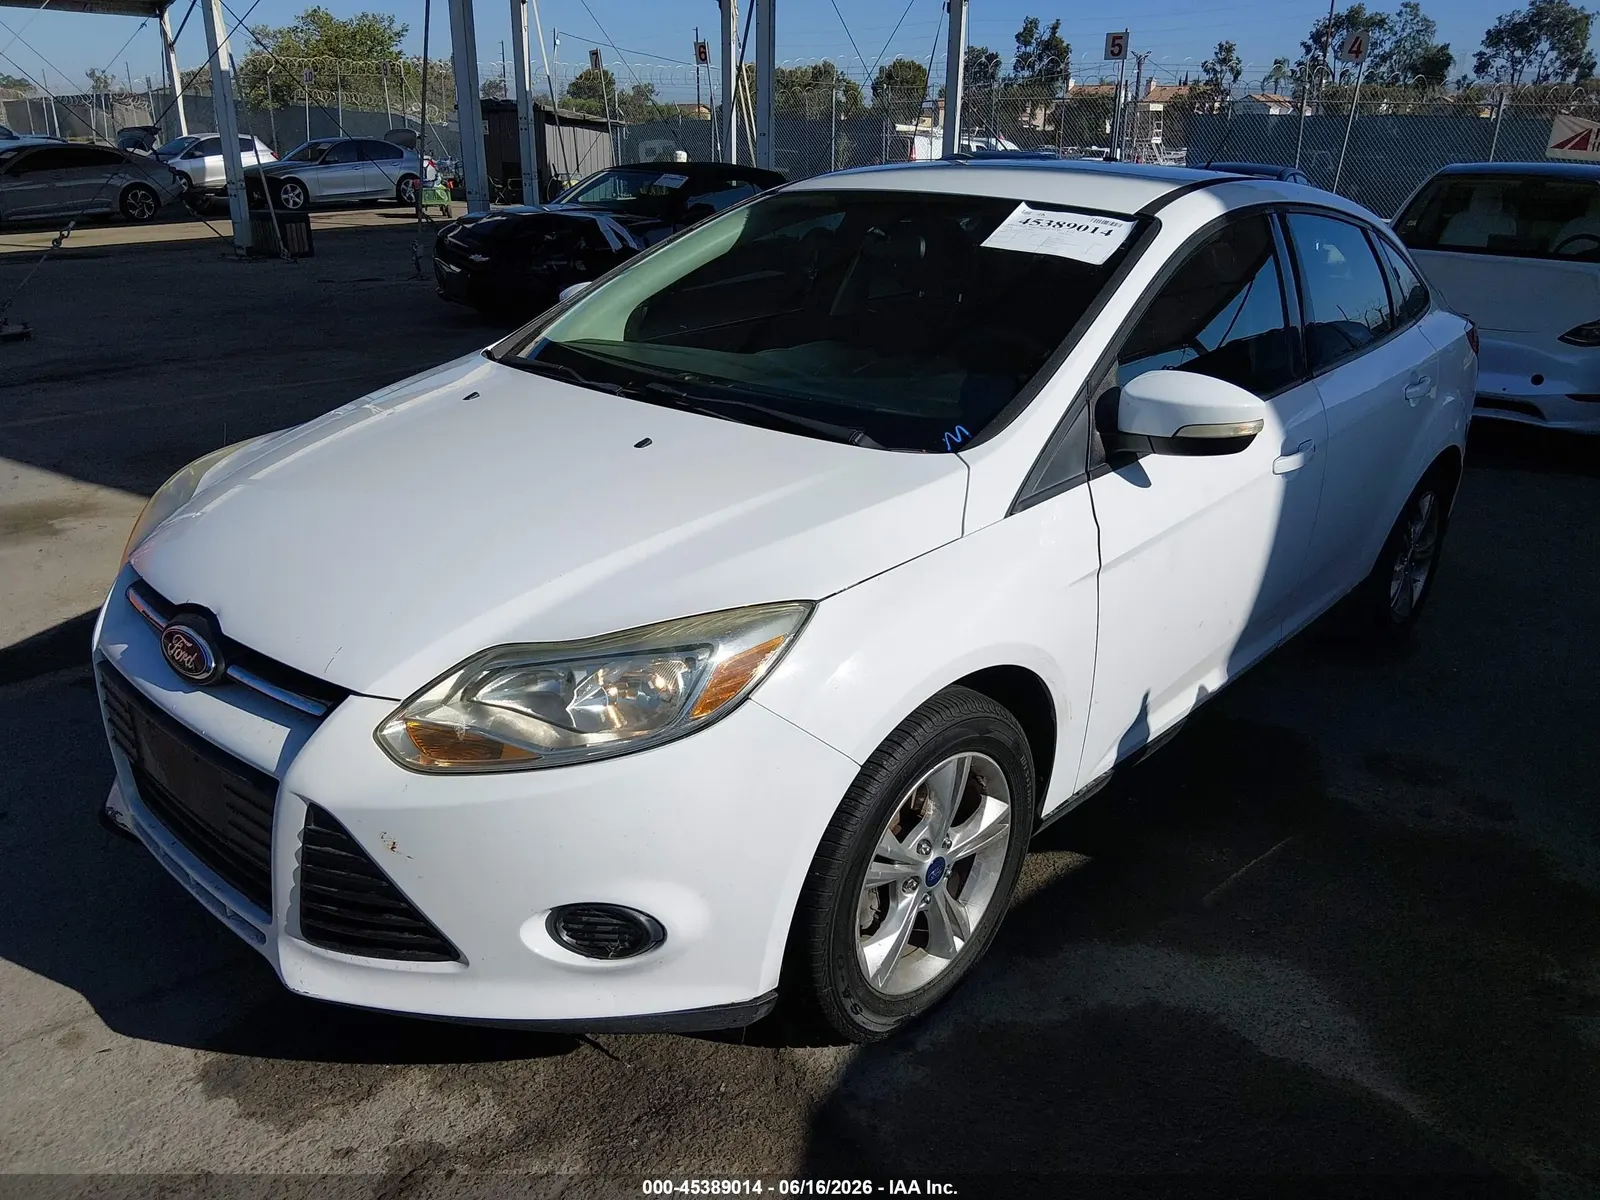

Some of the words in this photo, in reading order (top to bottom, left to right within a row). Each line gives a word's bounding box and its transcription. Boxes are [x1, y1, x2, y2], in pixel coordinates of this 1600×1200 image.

[698, 44, 707, 62] 6
[1110, 35, 1124, 57] 5
[1347, 35, 1363, 59] 4
[591, 51, 599, 69] 7
[304, 71, 313, 83] 10
[1018, 216, 1114, 238] 45389014
[168, 634, 199, 669] Ford
